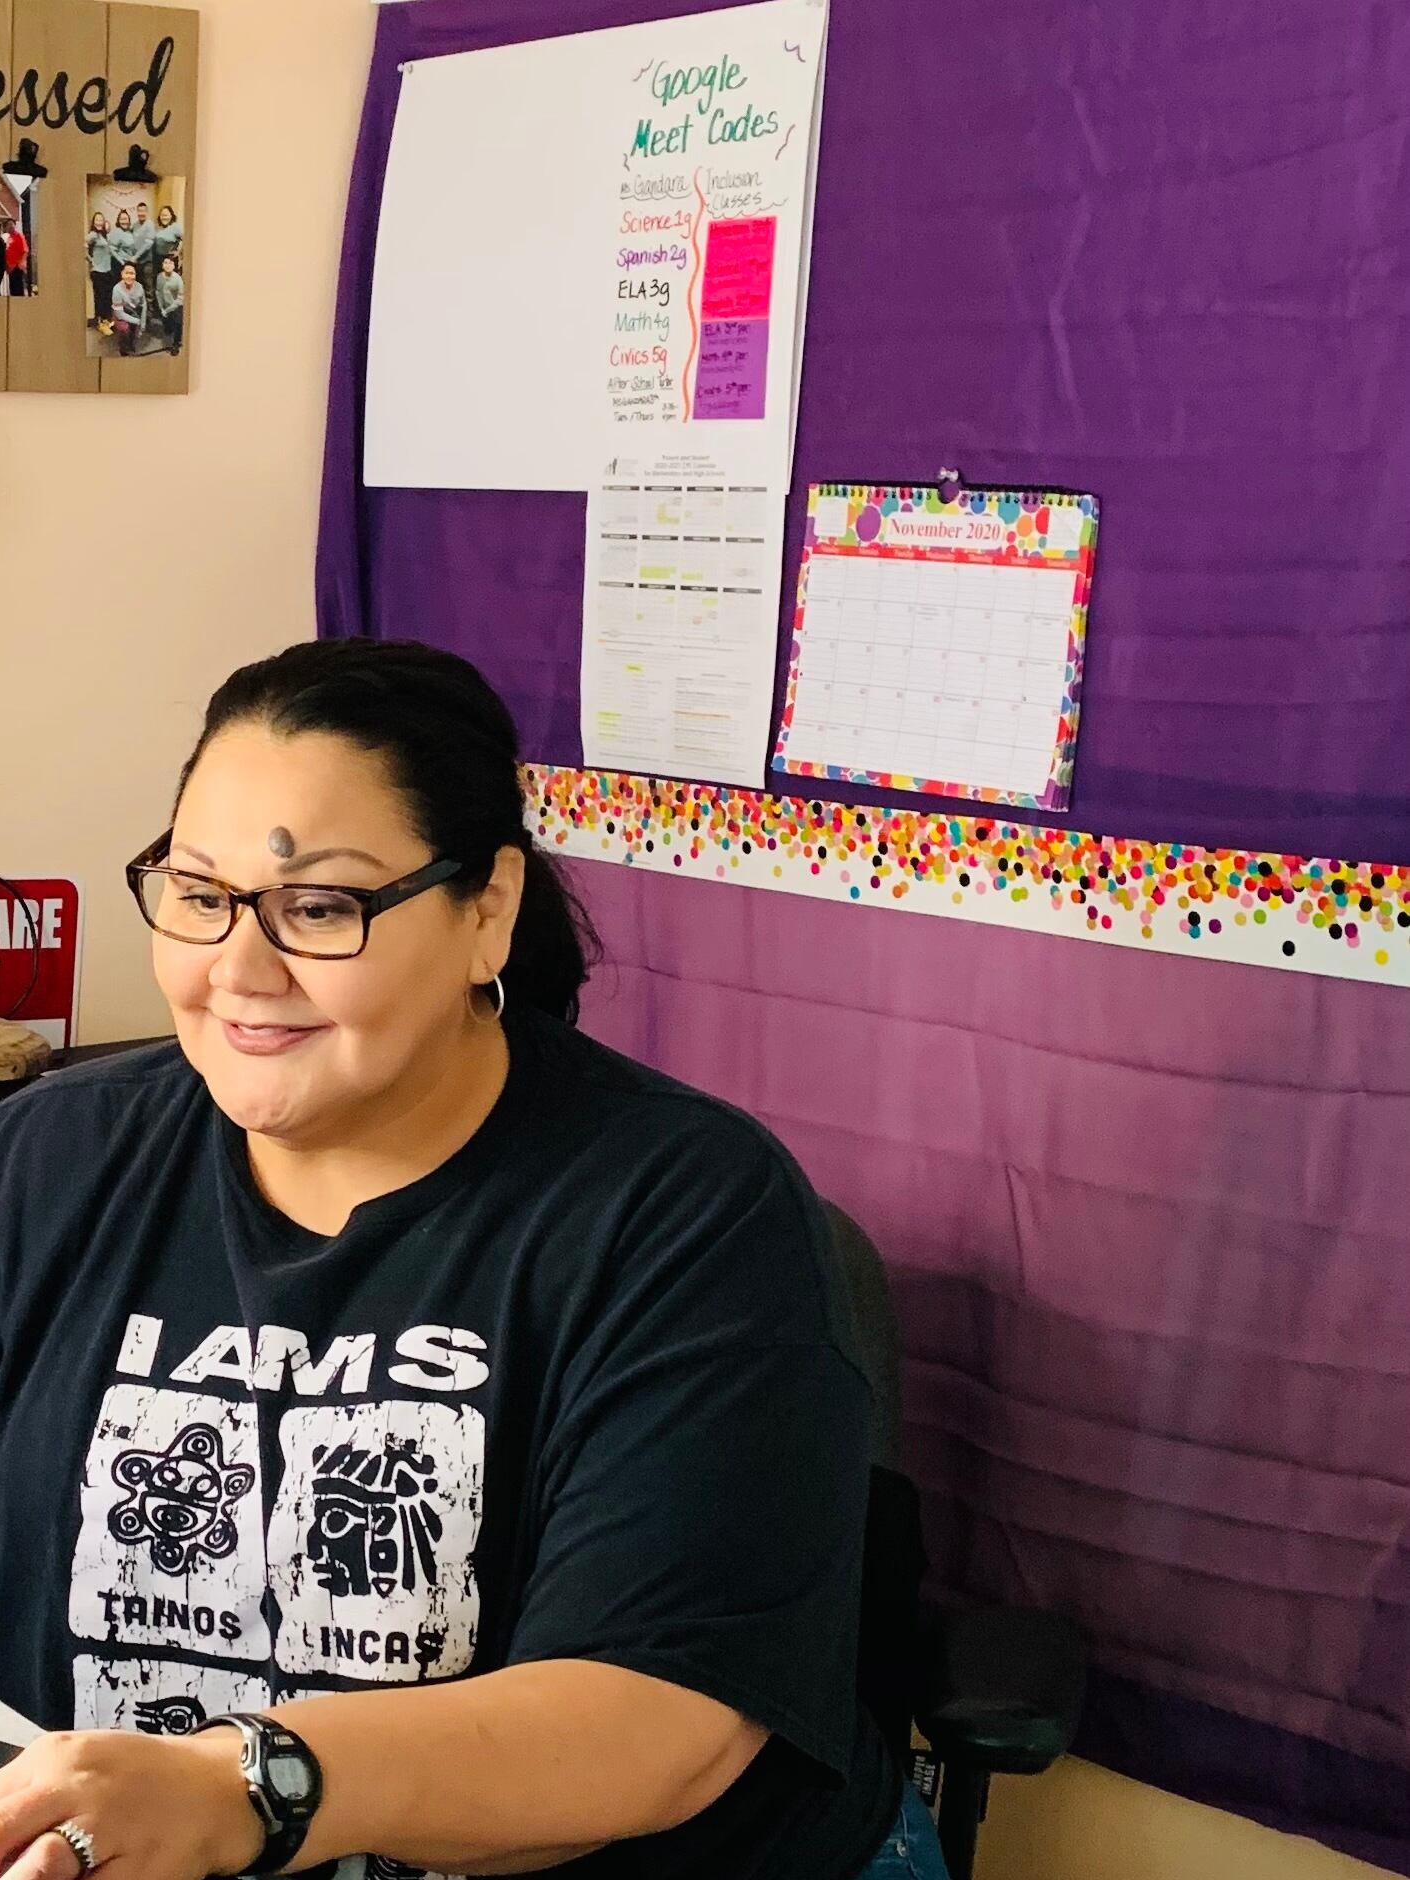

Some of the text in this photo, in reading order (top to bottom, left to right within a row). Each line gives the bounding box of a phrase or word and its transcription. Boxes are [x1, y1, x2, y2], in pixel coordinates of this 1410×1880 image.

[652, 54, 748, 115] Google
[631, 104, 778, 157] Meet Codes
[707, 169, 762, 194] Inclusion
[620, 209, 671, 234] Science
[617, 244, 668, 271] Spanish
[618, 280, 646, 299] ELA
[614, 312, 651, 332] Math
[610, 345, 649, 366] Civics
[891, 518, 1000, 540] November 2020
[97, 1590, 243, 1641] TAINOS
[321, 1625, 443, 1666] INCAS
